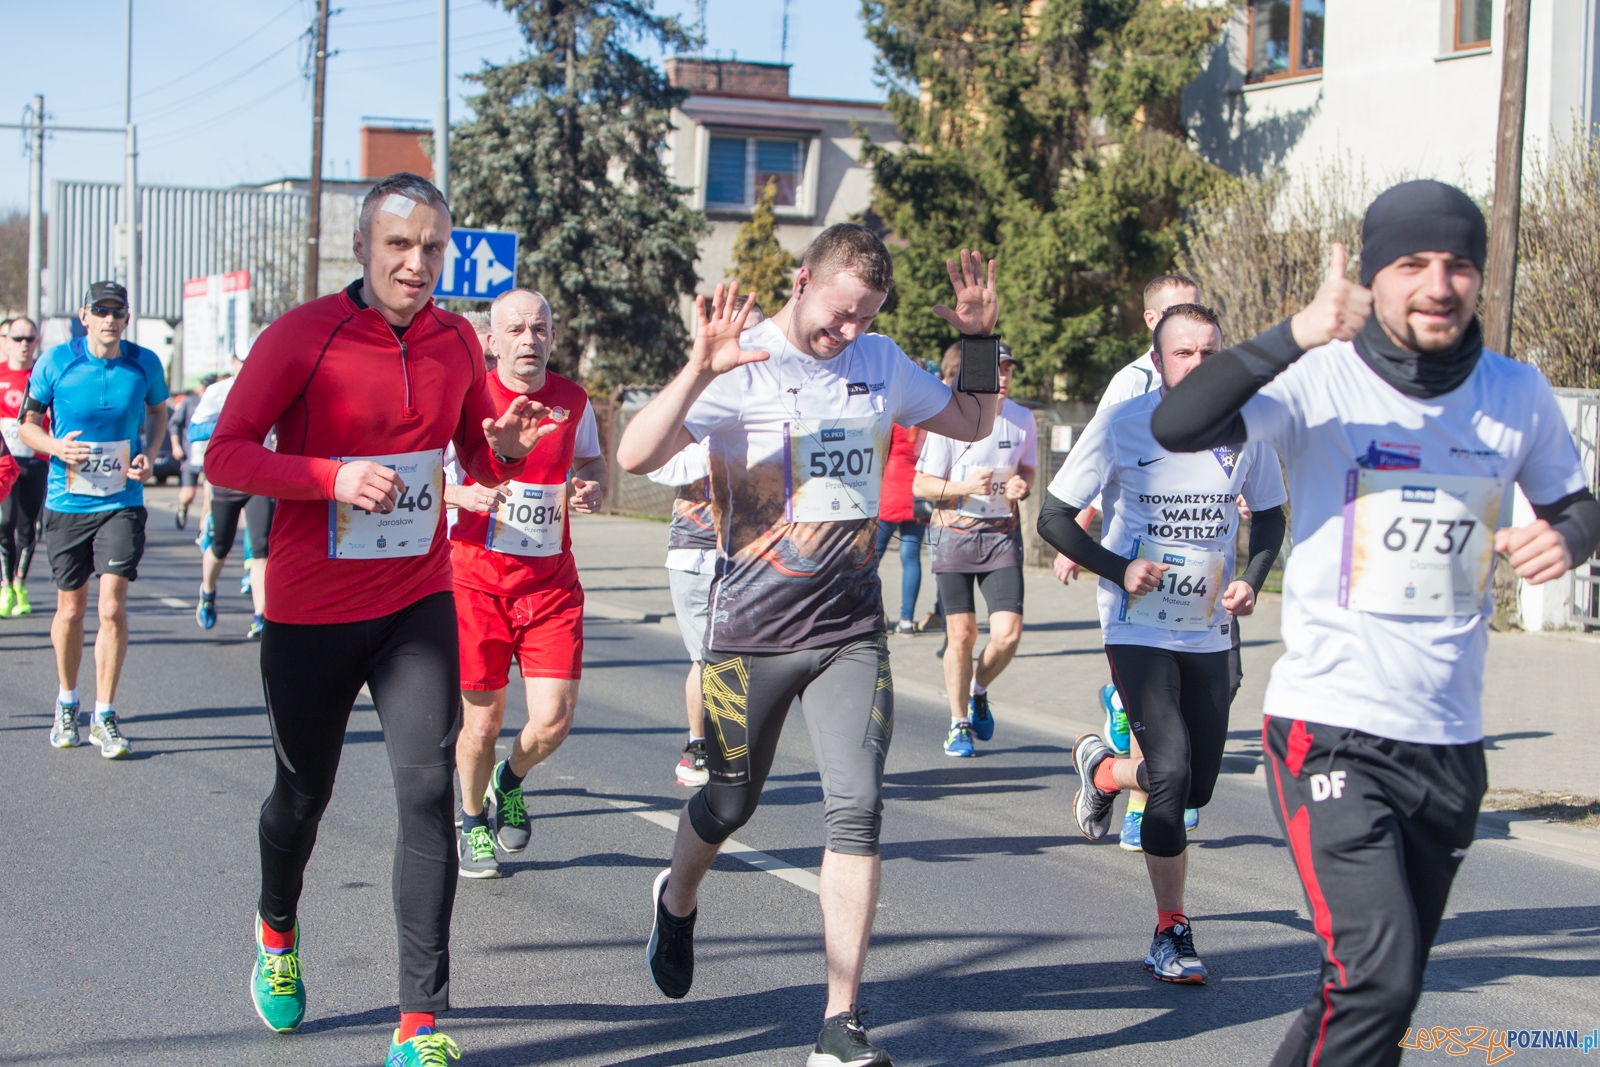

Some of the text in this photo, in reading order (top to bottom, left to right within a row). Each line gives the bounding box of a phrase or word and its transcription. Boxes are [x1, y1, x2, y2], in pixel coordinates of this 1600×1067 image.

[81, 458, 122, 474] 2754
[809, 447, 875, 478] 5207
[825, 479, 868, 489] Przemysław
[990, 481, 1007, 497] 95
[352, 483, 433, 515] 46
[507, 502, 562, 525] 10814
[1162, 507, 1225, 522] WALKA
[377, 518, 414, 528] Jarosław
[524, 526, 549, 534] Przemek
[1147, 523, 1230, 539] KOSTRZYN
[1383, 517, 1477, 555] 6737
[1410, 559, 1451, 571] Damian
[1162, 596, 1191, 607] Mateusz
[1310, 771, 1347, 802] DF
